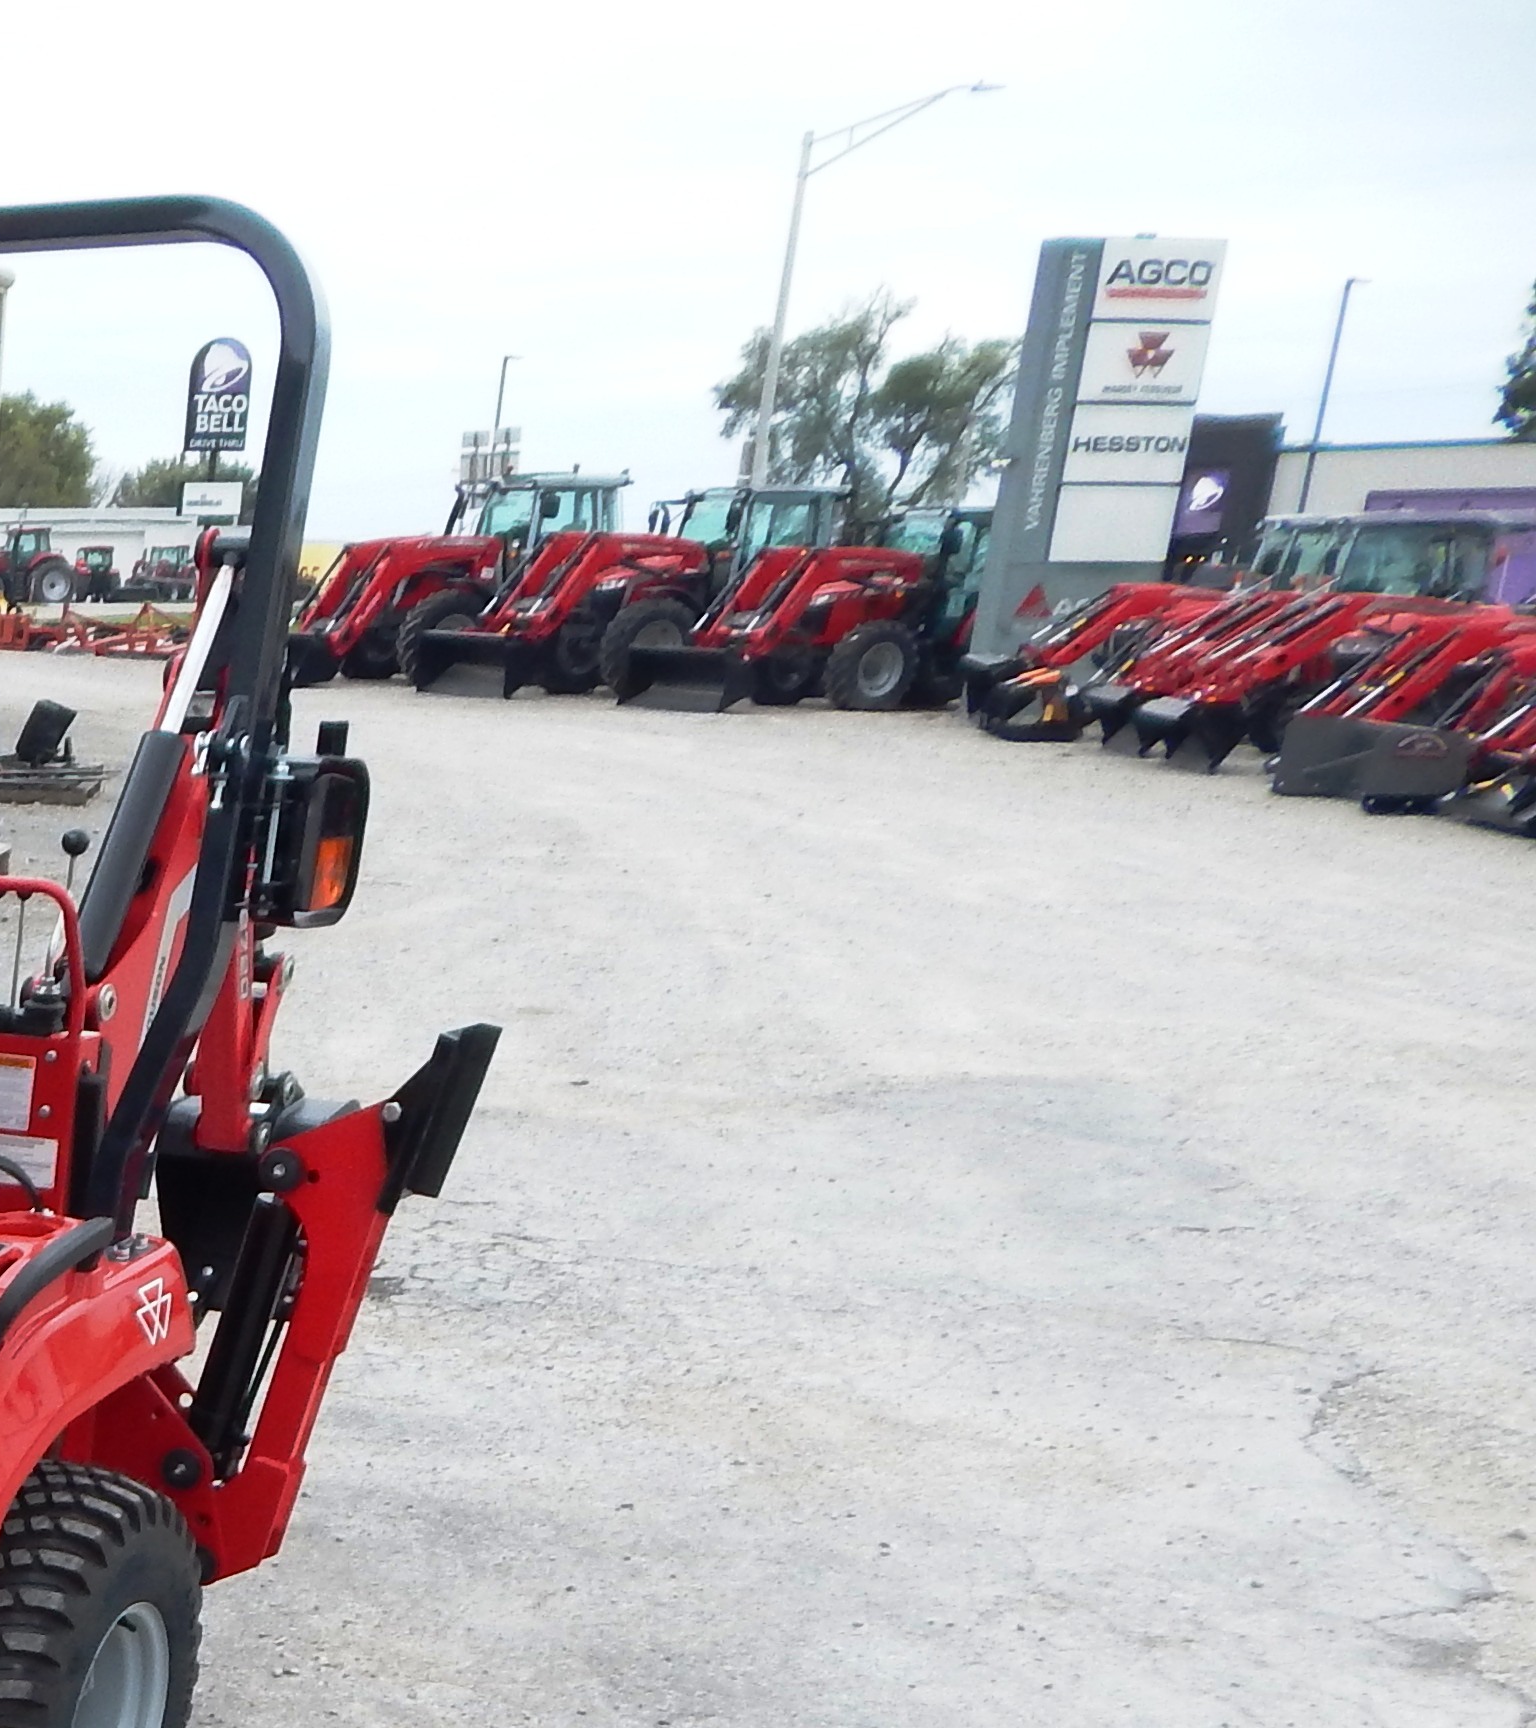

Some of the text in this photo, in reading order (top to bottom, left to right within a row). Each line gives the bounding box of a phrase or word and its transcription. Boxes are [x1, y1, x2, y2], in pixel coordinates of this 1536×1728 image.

[1106, 258, 1216, 286] AGCO
[1023, 251, 1087, 531] VAHRENBERG IMPLEMENT
[193, 393, 248, 413] TACO
[195, 412, 245, 433] BELL
[1072, 435, 1188, 453] HESSTON
